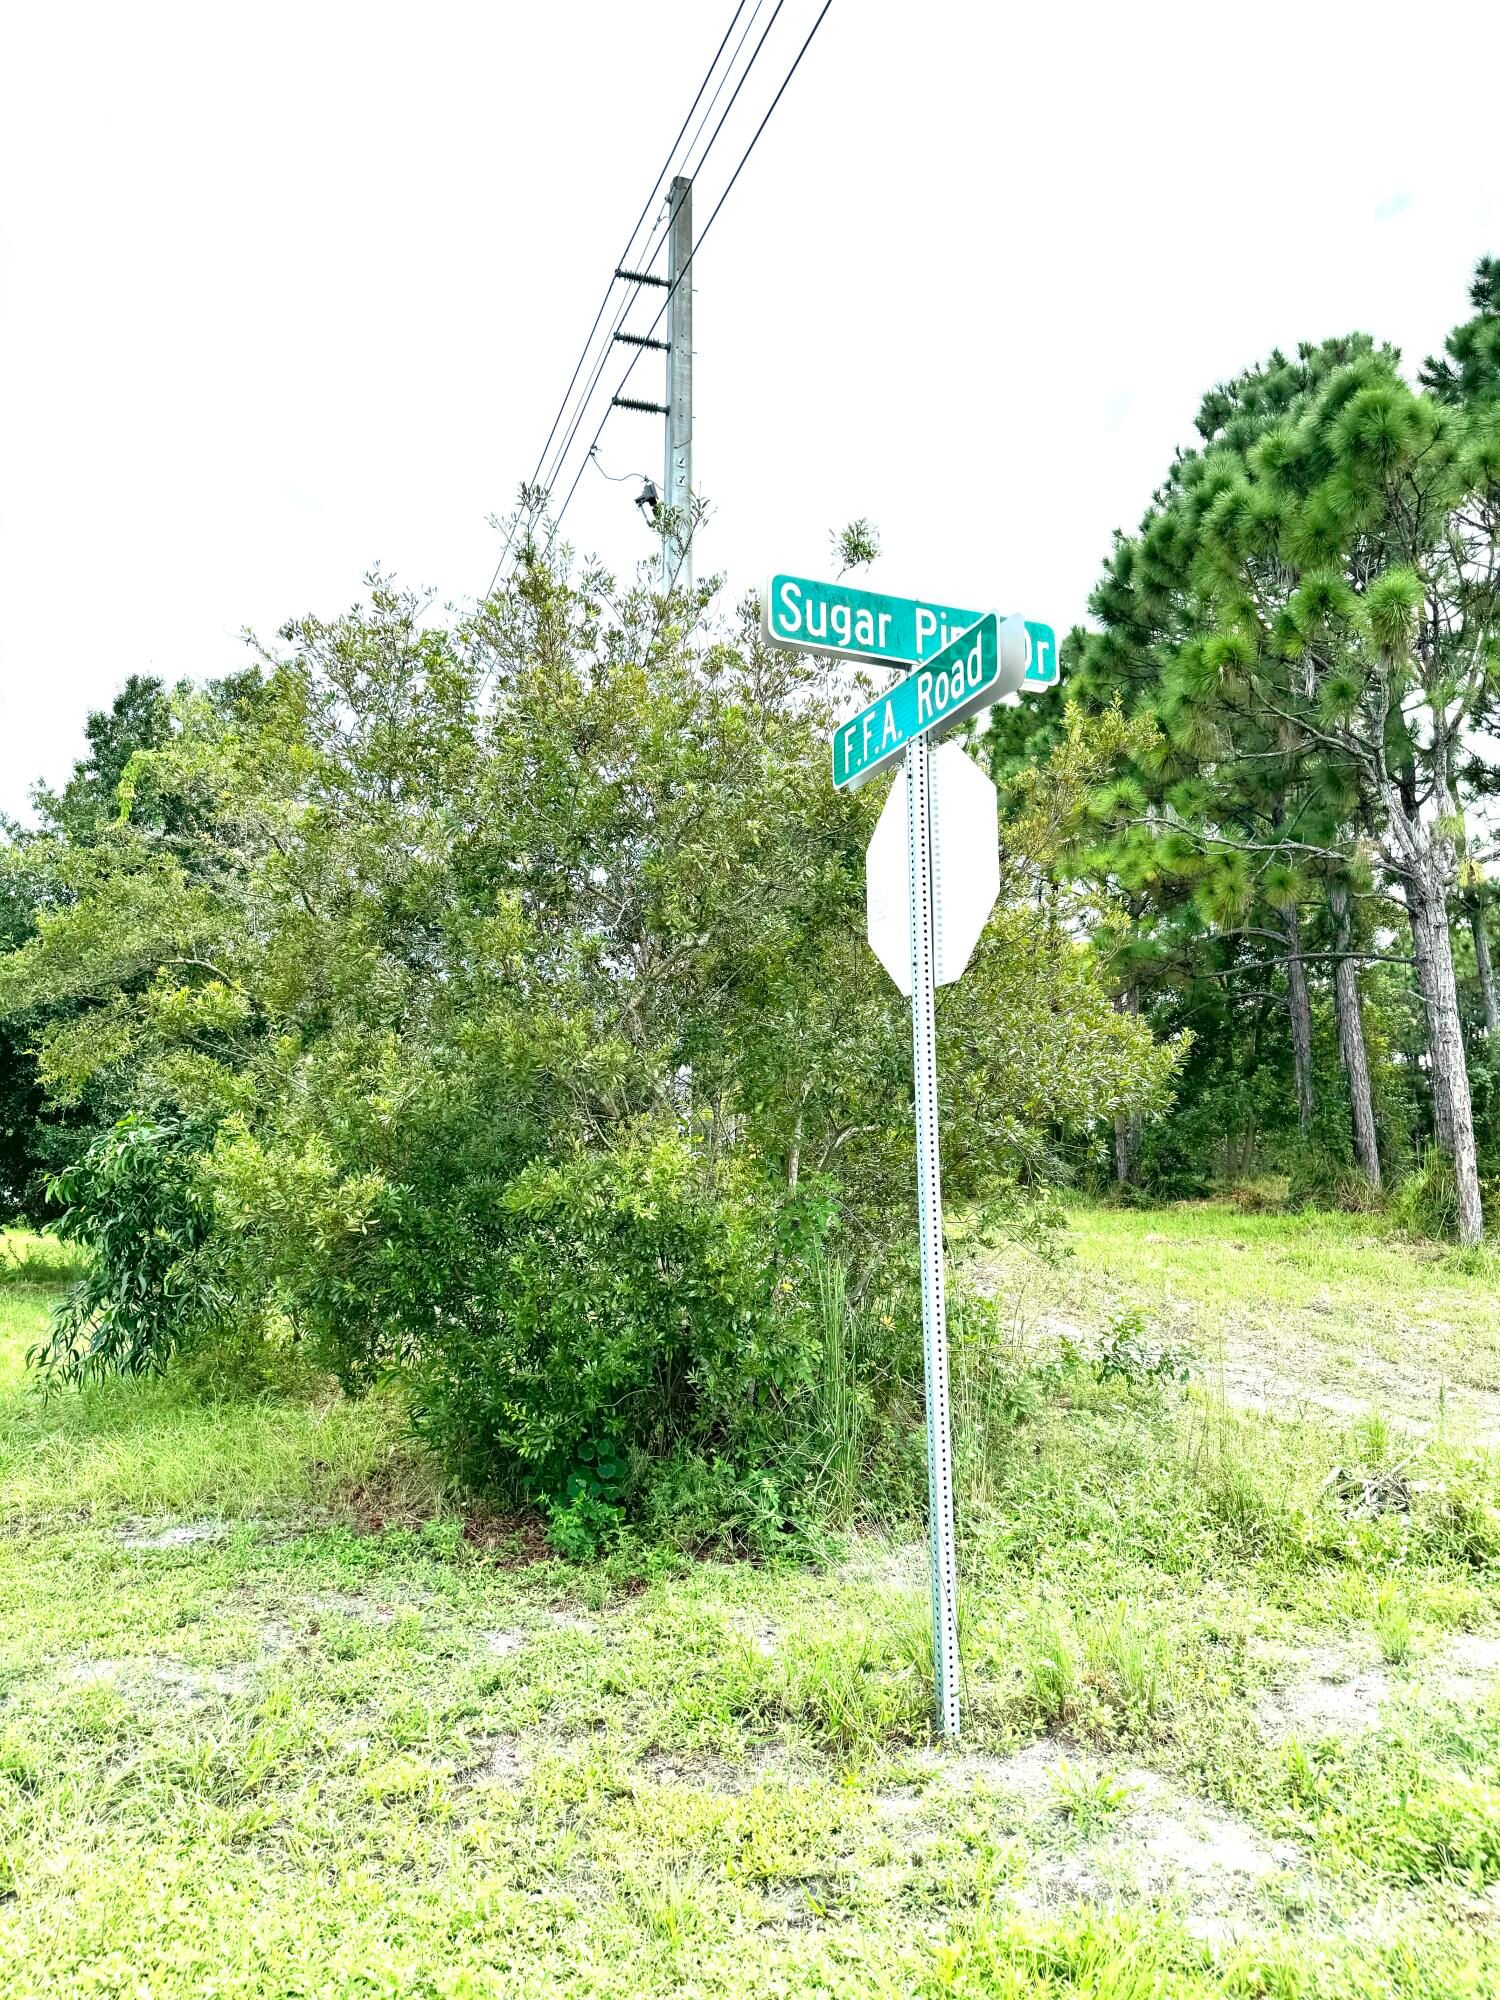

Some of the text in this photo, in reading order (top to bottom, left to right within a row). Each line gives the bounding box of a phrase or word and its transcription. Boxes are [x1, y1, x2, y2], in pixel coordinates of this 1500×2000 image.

[779, 582, 892, 648] Sugar
[844, 629, 983, 775] F.F.A. Road
